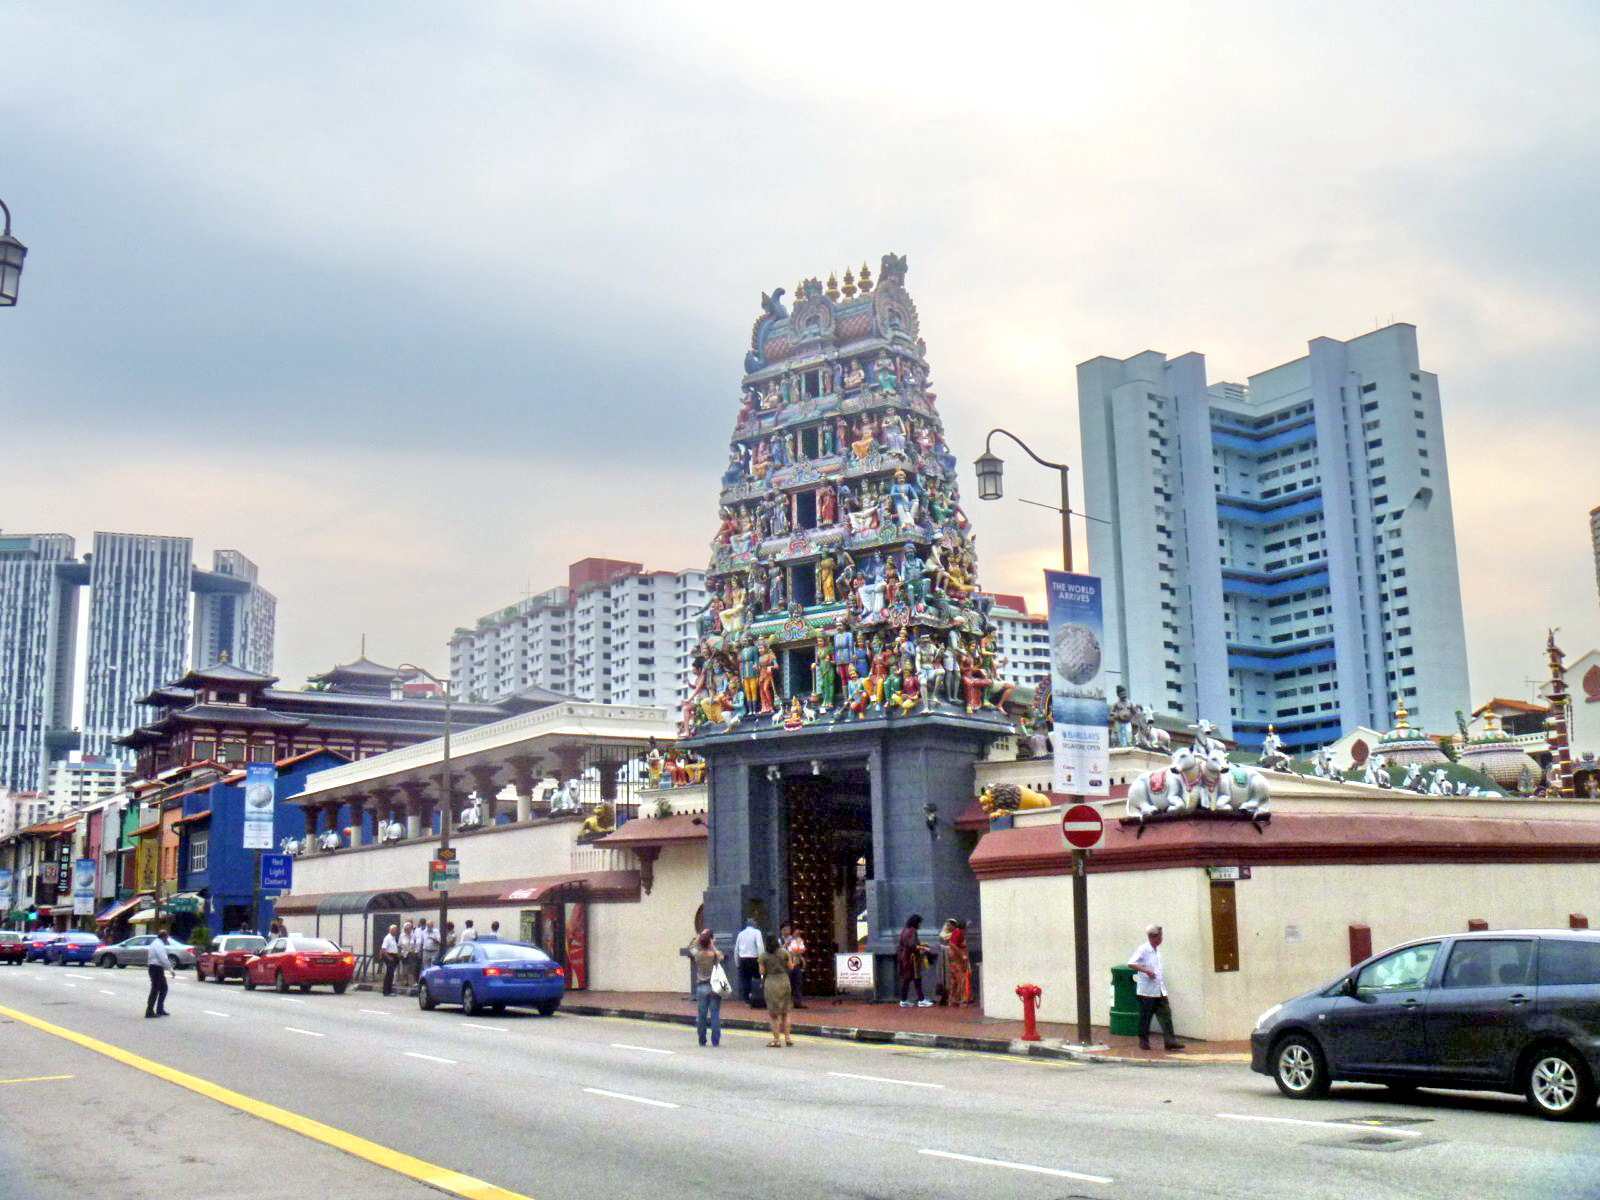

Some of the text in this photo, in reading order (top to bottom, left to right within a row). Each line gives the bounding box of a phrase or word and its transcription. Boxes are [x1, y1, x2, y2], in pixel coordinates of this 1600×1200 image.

[1052, 582, 1095, 595] THE WORLD
[1058, 591, 1090, 603] ARRIVES
[272, 857, 284, 866] Red
[269, 868, 285, 878] Light
[264, 877, 287, 886] Camera
